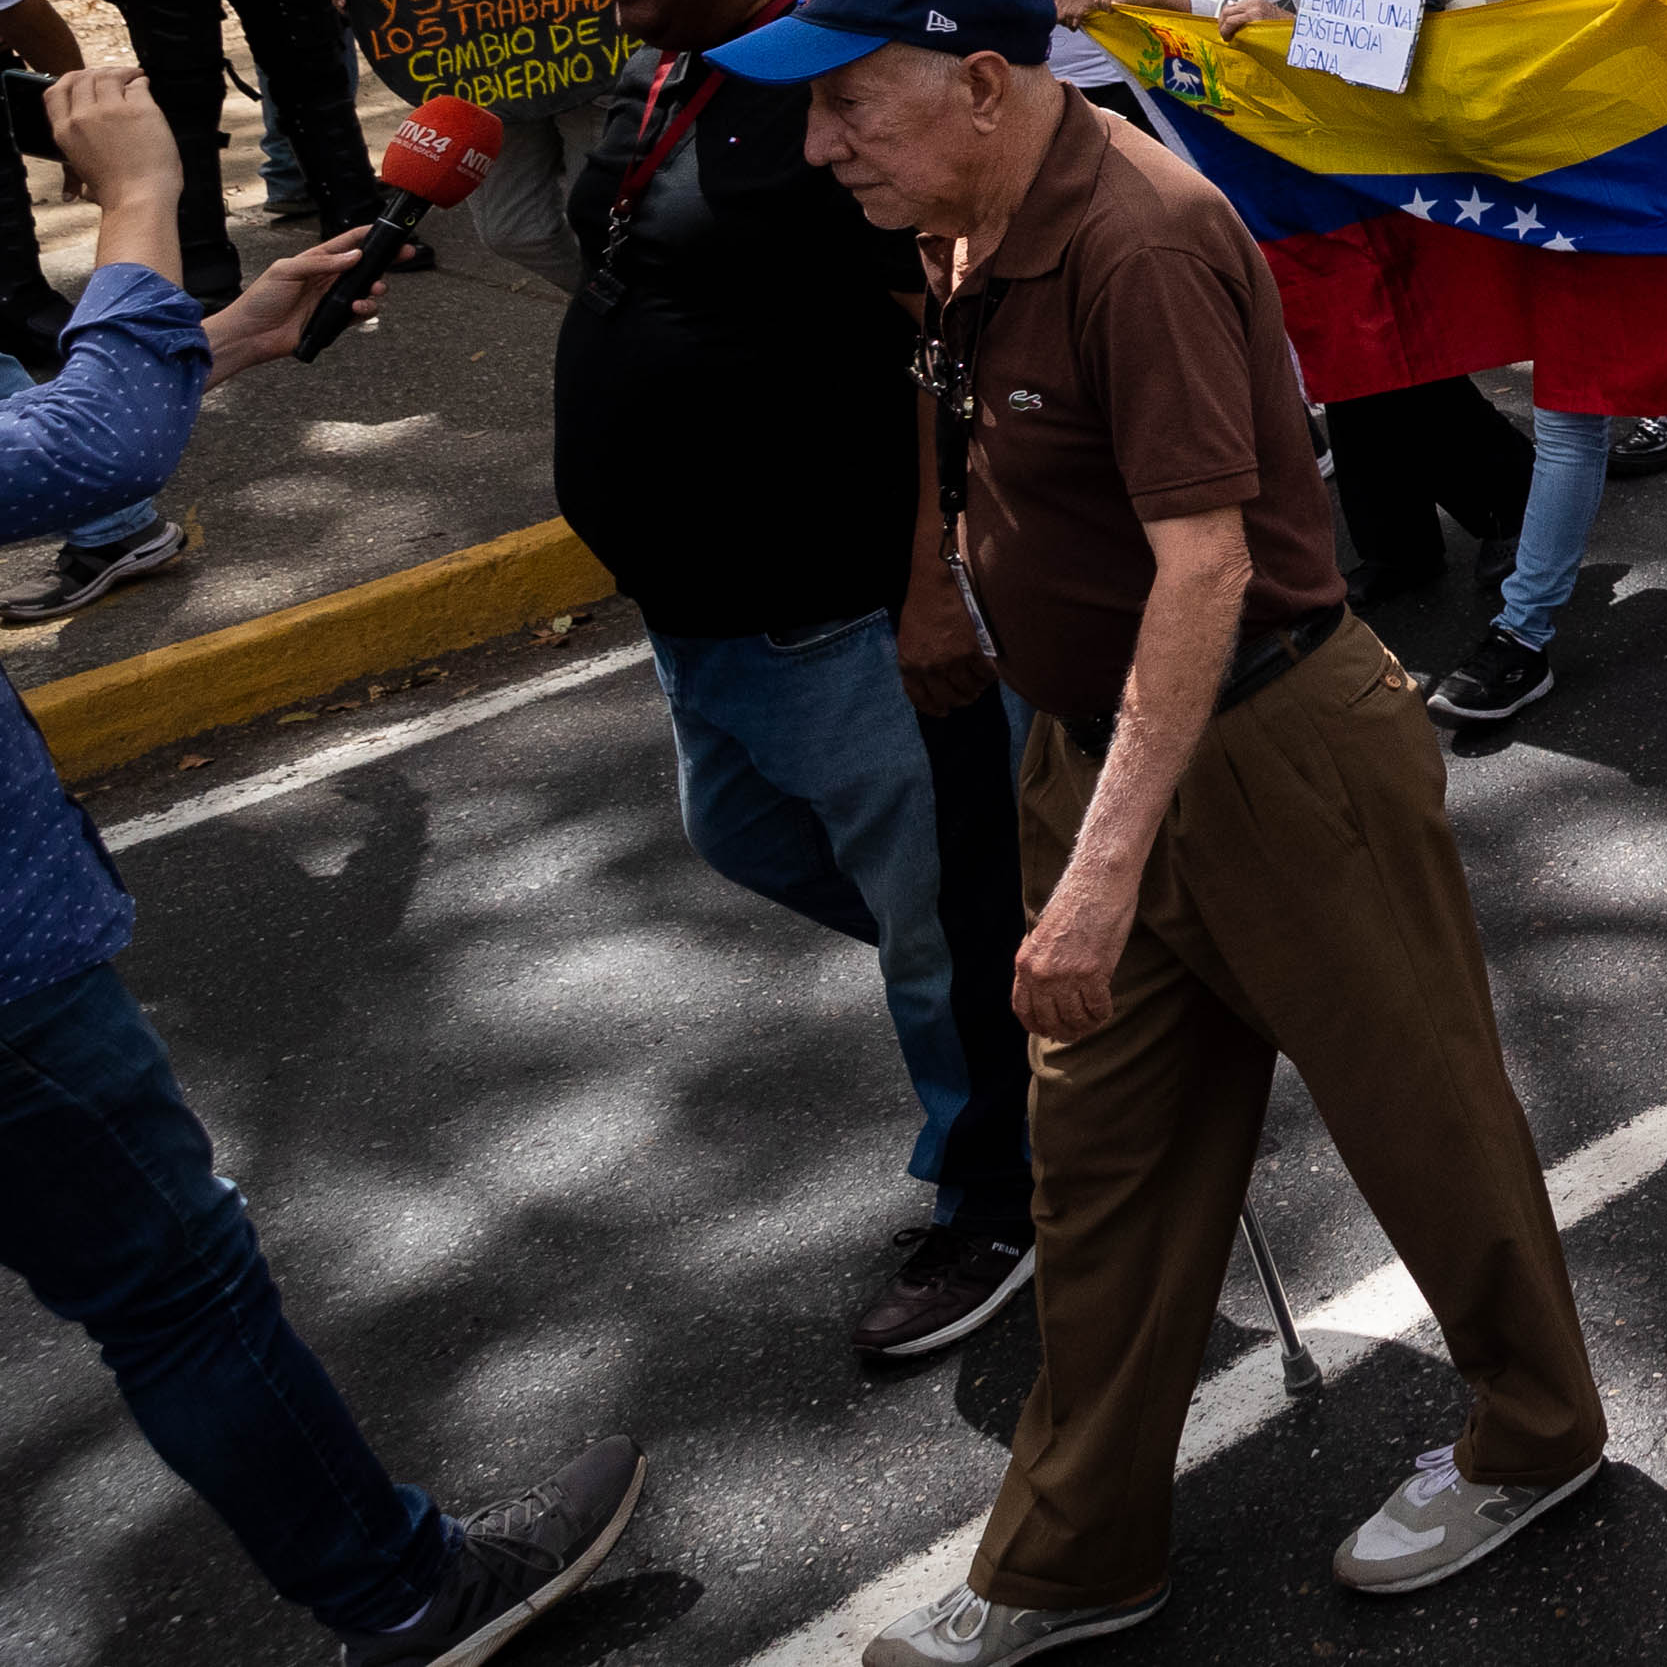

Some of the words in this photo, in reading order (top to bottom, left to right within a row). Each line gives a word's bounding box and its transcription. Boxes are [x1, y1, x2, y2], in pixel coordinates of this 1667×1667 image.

[1295, 14, 1384, 54] EXISTENCIA
[1377, 2, 1412, 31] UNA
[370, 17, 448, 61] LOS
[408, 26, 536, 83] CAMBIO
[549, 16, 601, 54] DE
